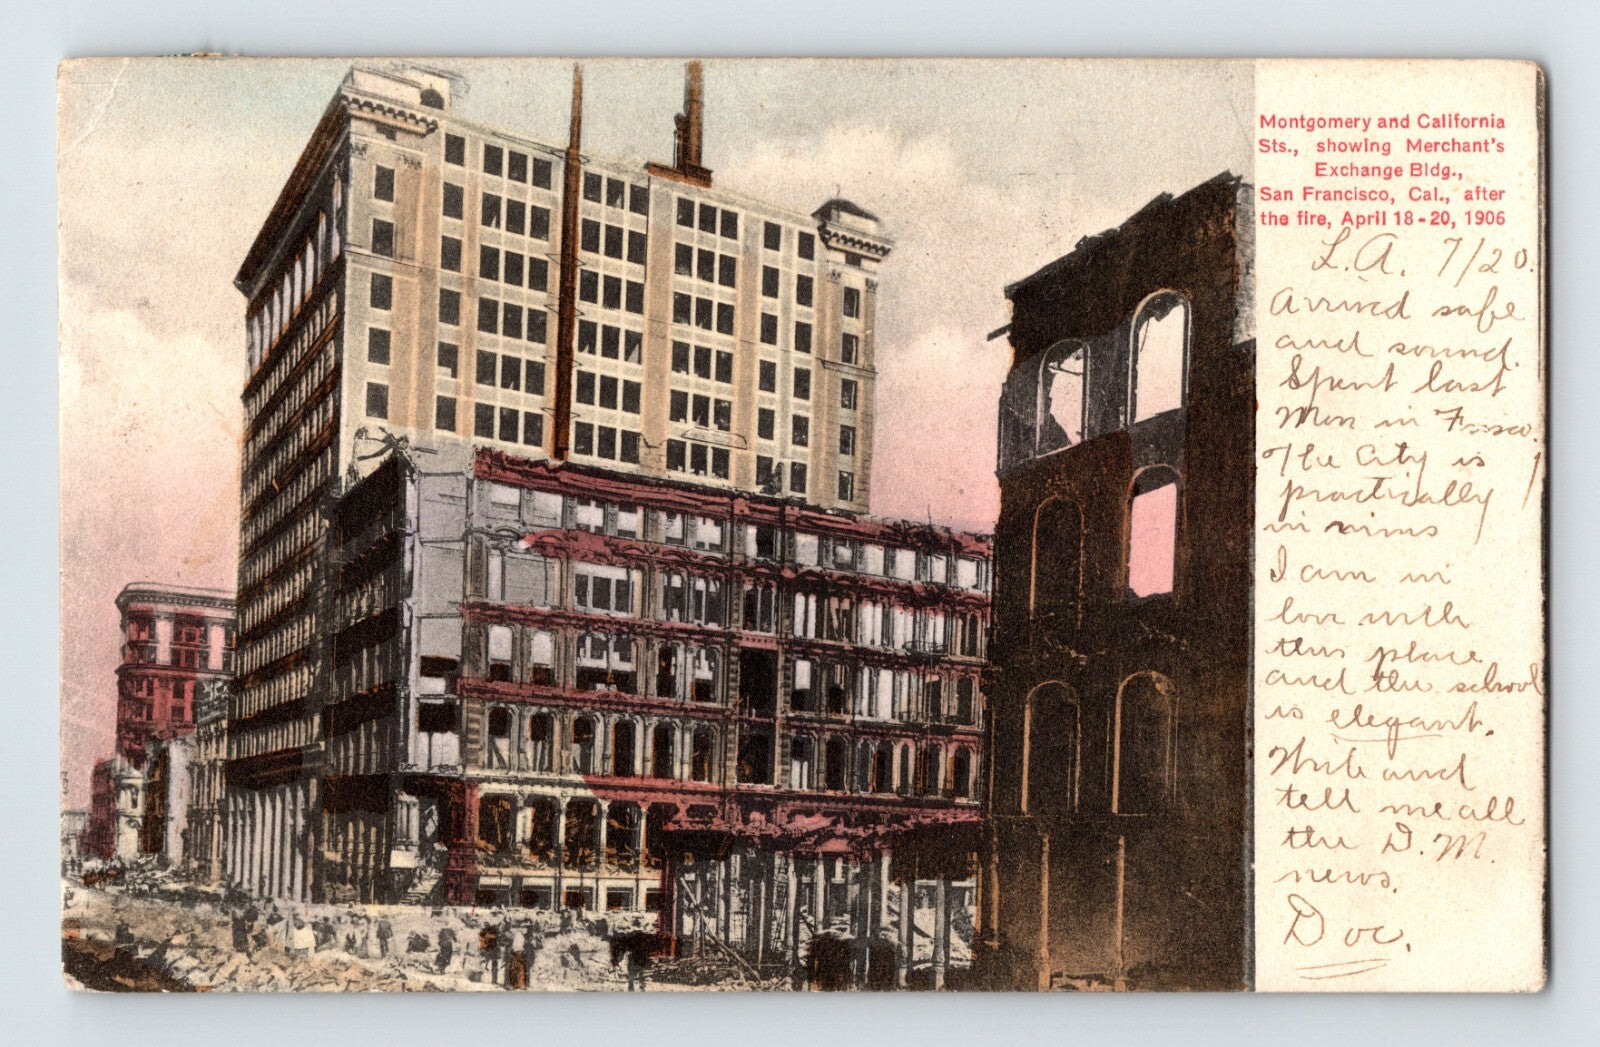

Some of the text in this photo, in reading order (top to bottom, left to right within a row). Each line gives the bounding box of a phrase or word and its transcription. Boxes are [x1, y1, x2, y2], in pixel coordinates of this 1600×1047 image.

[1260, 113, 1506, 132] Montgomery and California
[1259, 138, 1505, 156] Sts., showing Merchant's
[1315, 162, 1463, 180] Exchange Bldg.,
[1260, 186, 1506, 205] San Francisco, Cal., after
[1260, 211, 1289, 226] the
[1297, 211, 1332, 229] fire,
[1341, 210, 1387, 229] April
[1465, 211, 1506, 226] 1906
[1431, 285, 1525, 333] safe
[1274, 331, 1373, 357] and
[1412, 360, 1507, 397] last
[1374, 405, 1420, 427] in
[1262, 443, 1341, 476] The
[1451, 451, 1485, 467] is
[1263, 510, 1311, 532] in
[1279, 474, 1494, 545] practically
[1270, 545, 1451, 584] I am in
[1265, 596, 1471, 629] love with
[1265, 636, 1483, 681] this place
[1265, 661, 1545, 696] and the school
[1264, 700, 1495, 760] is elegant.
[1382, 753, 1476, 791] and
[1275, 783, 1526, 826] tell me all
[1280, 824, 1360, 849] the
[1272, 867, 1398, 894] news.
